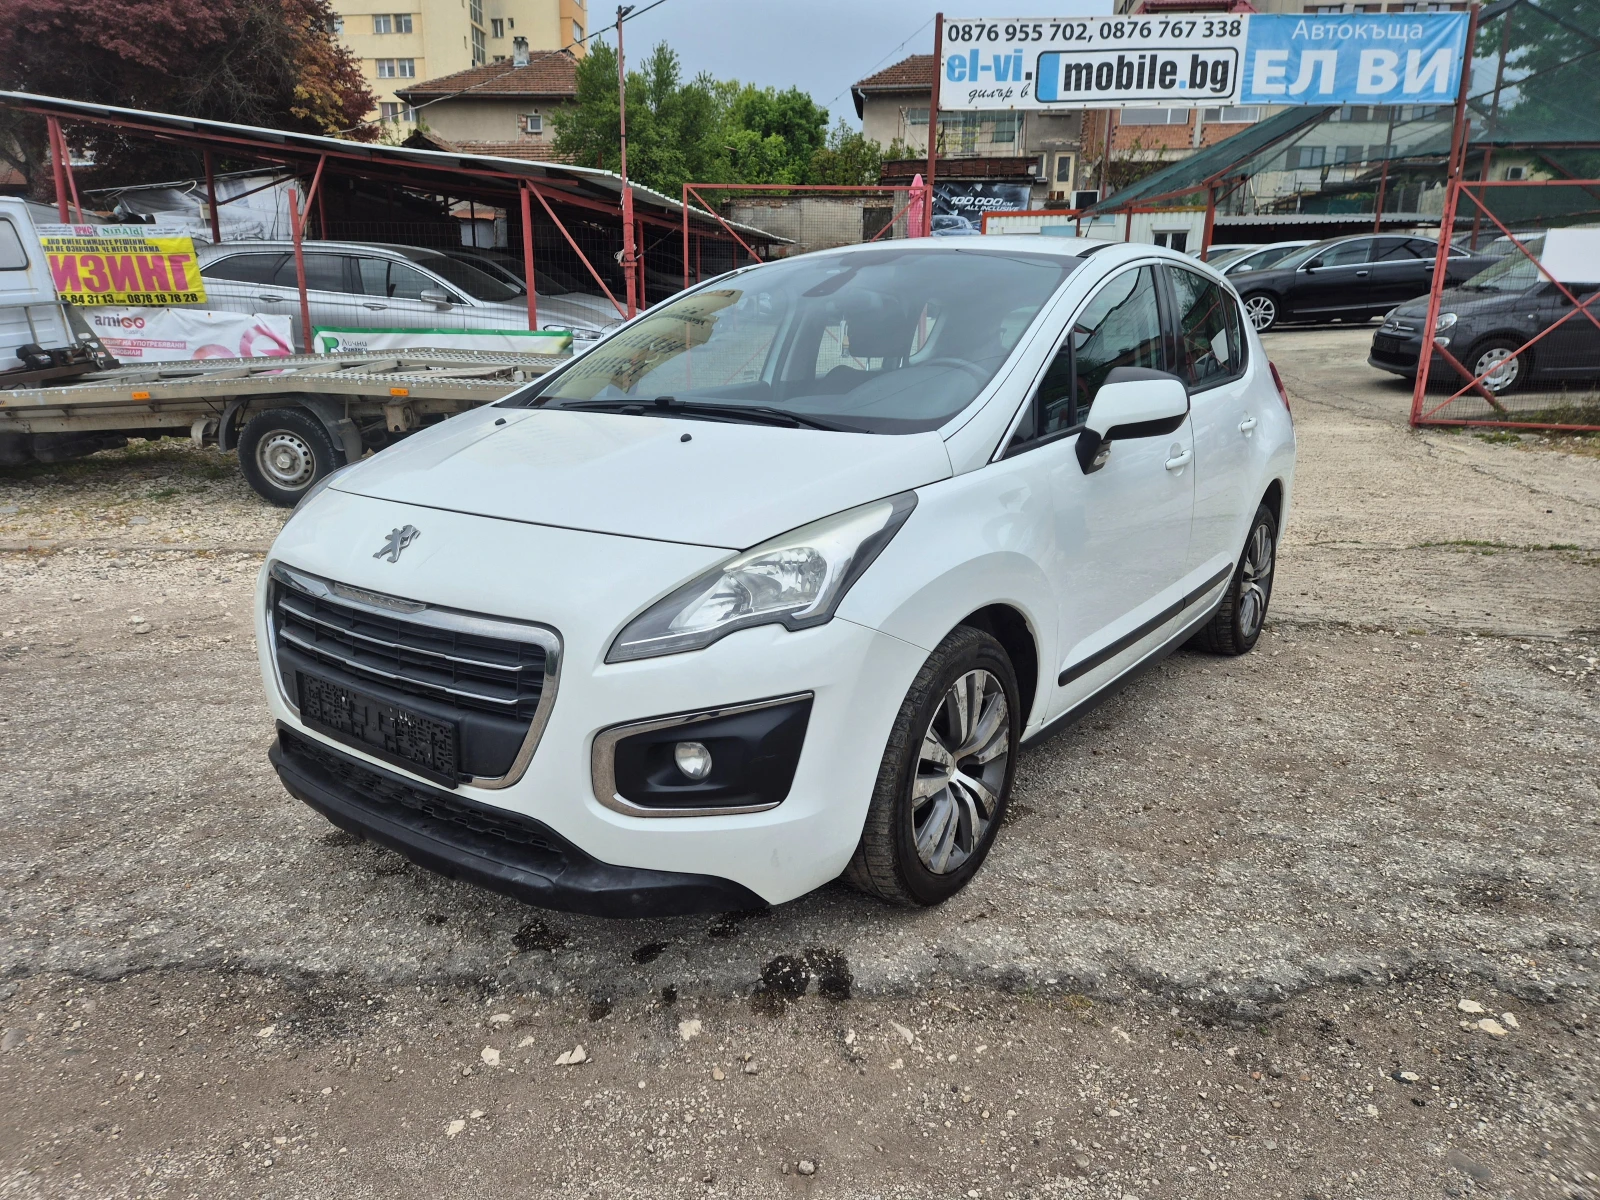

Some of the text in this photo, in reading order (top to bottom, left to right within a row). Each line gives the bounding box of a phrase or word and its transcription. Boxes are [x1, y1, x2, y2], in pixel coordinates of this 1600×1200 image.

[947, 19, 1242, 44] 0876 955 702, 0876 767 338
[1291, 19, 1423, 43] Автокъща
[1062, 53, 1230, 94] mobile.bg
[1250, 48, 1453, 96] ЕЛ ВИ
[968, 82, 1031, 104] дилър в
[950, 196, 974, 205] 100
[974, 197, 1004, 206] 000
[47, 238, 60, 246] АКО
[50, 254, 191, 293] ИЗИНГ
[70, 294, 85, 304] 84
[87, 294, 100, 304] 31
[101, 294, 115, 304] 13
[127, 293, 153, 304] 0878
[154, 293, 167, 304] 18
[168, 293, 182, 303] 78
[183, 293, 199, 303] 28
[102, 338, 121, 346] ИЗИНГ
